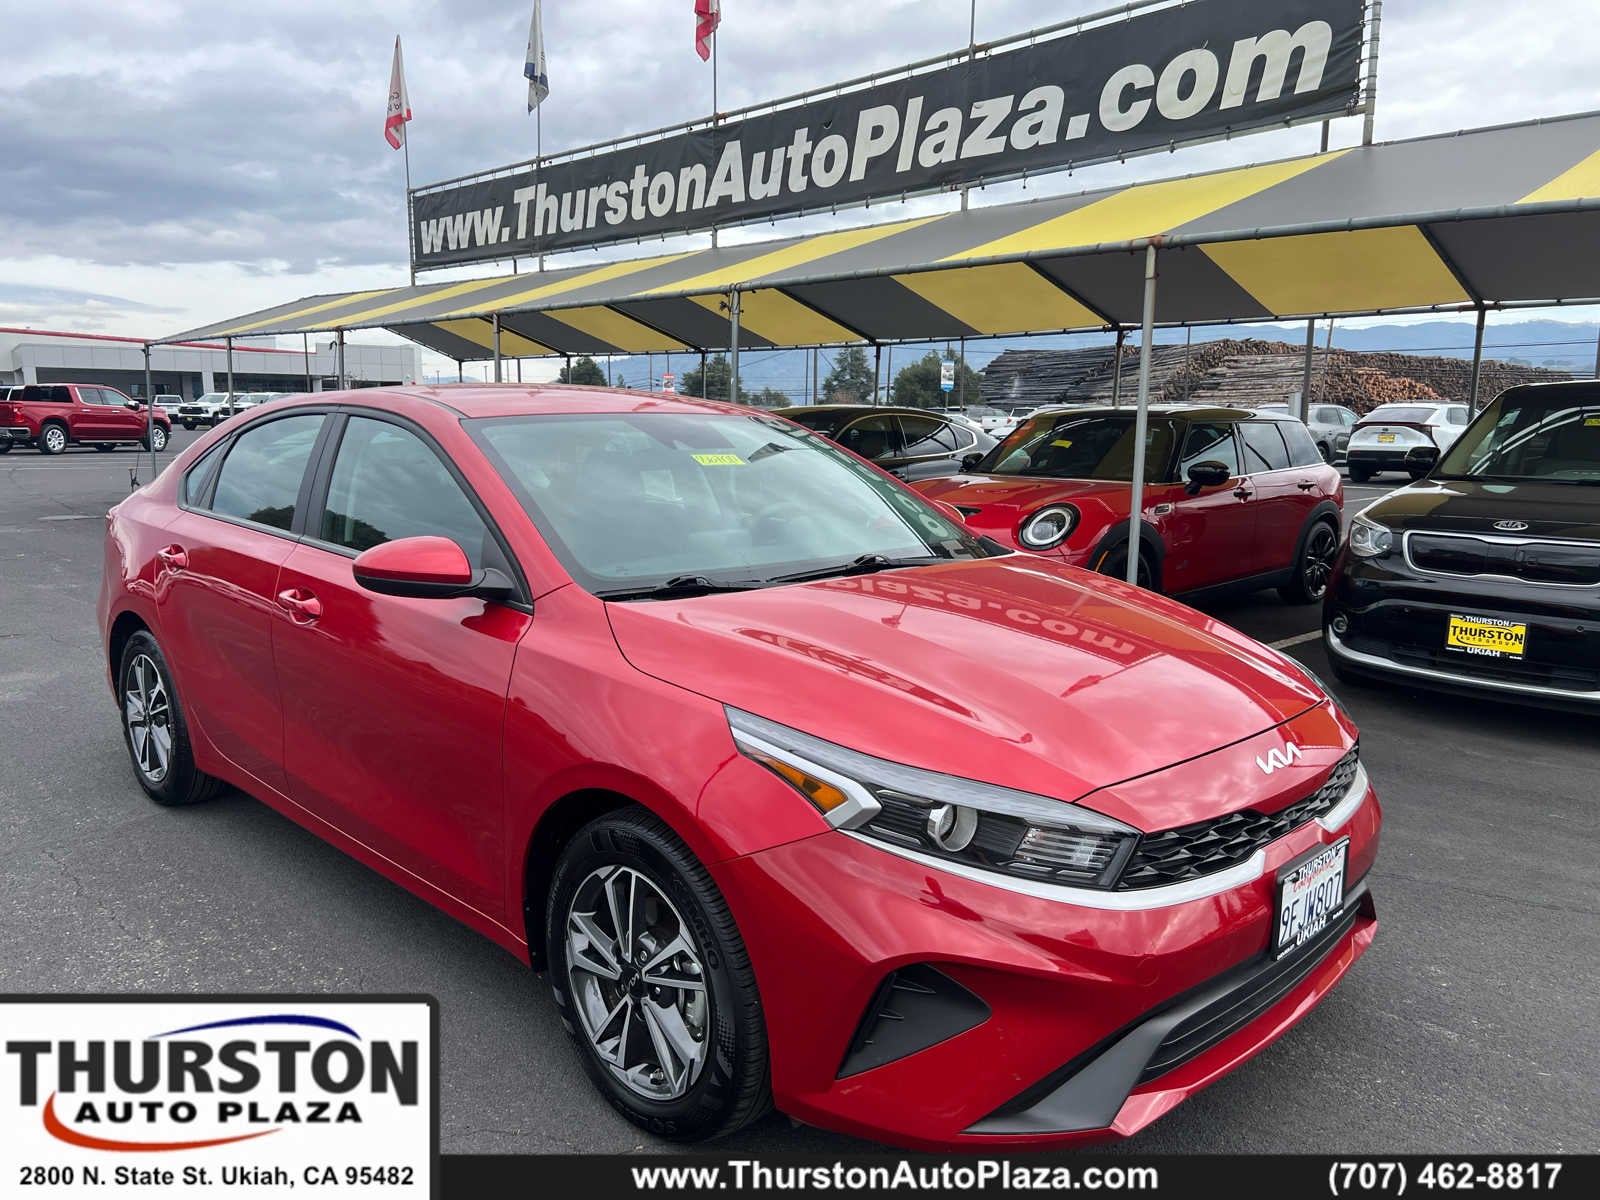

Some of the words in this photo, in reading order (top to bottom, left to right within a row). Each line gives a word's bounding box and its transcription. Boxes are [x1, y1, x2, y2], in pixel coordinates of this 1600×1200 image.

[420, 20, 1332, 255] www.ThurstonAutoPlaza.com
[1450, 625, 1524, 645] THURSTON
[1464, 615, 1510, 627] THURSTON
[1466, 647, 1501, 658] UKIAH
[1298, 846, 1338, 881] THURSTON
[1280, 870, 1342, 945] 9FJW807
[1296, 914, 1327, 946] UKIAH
